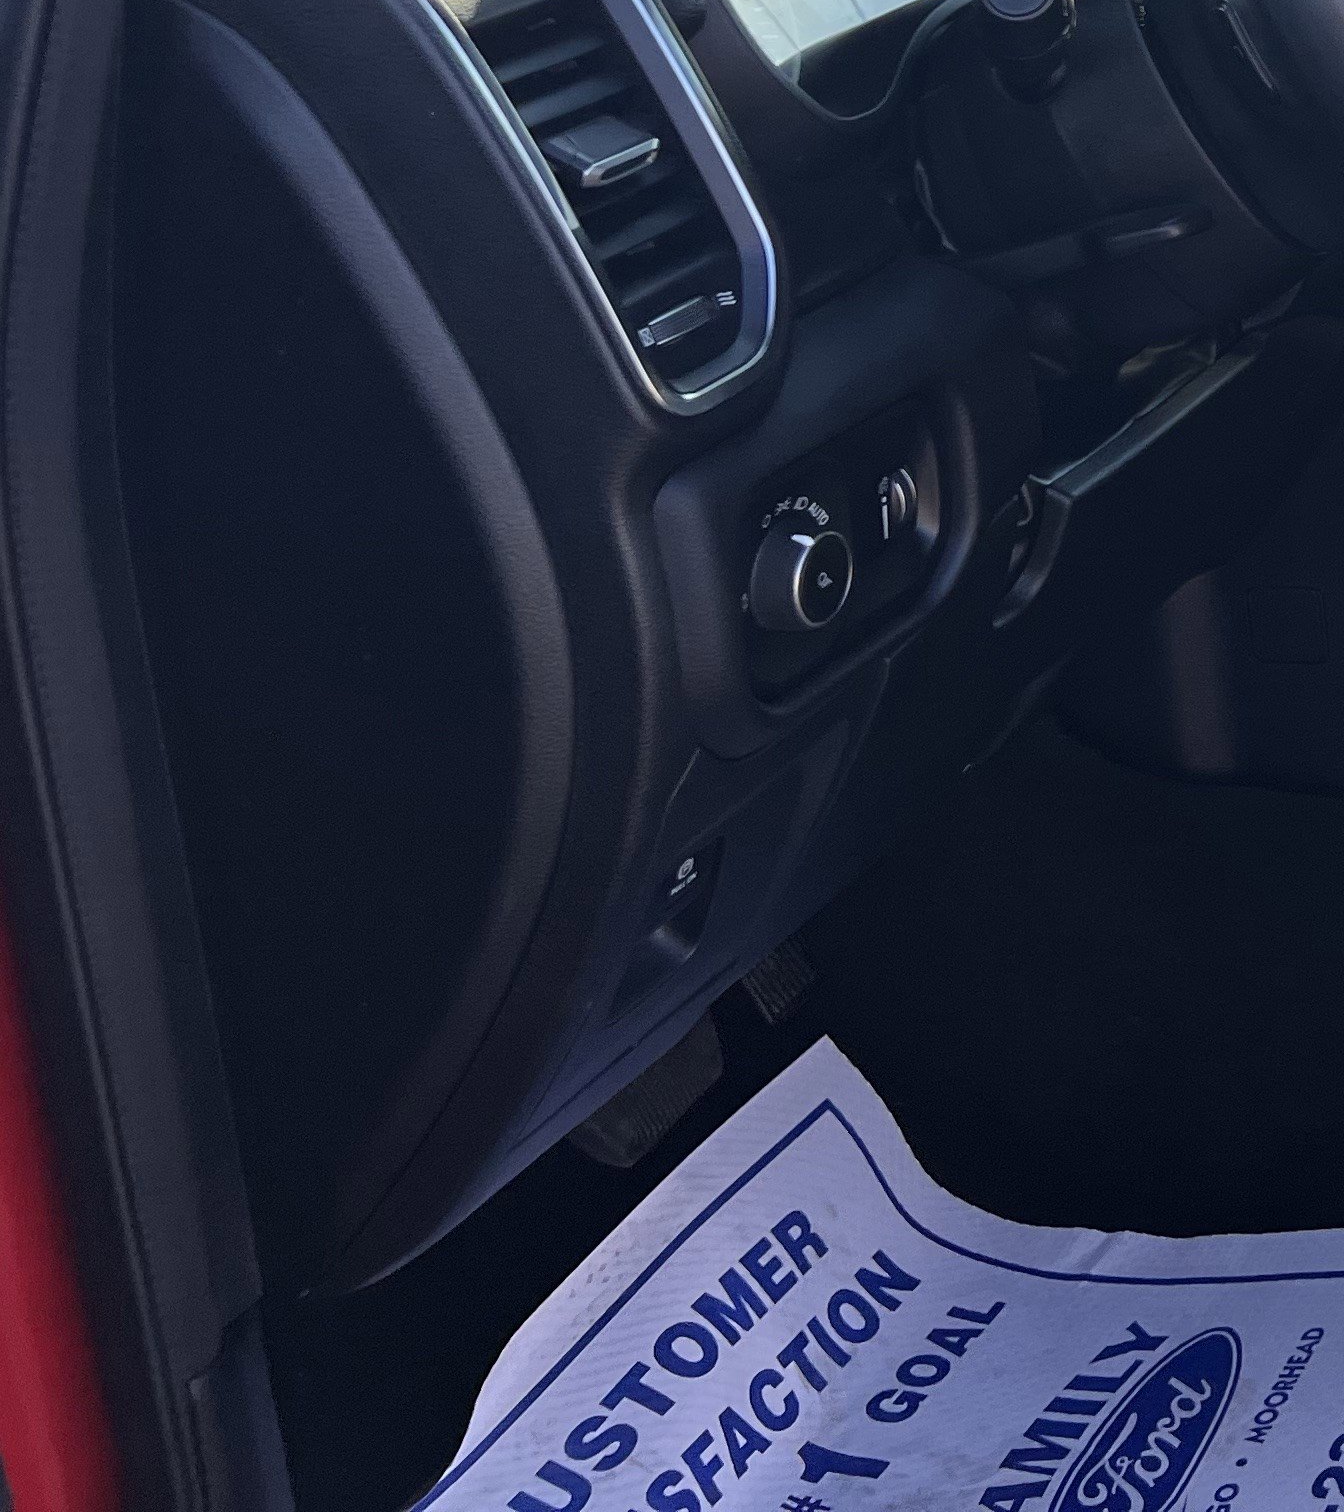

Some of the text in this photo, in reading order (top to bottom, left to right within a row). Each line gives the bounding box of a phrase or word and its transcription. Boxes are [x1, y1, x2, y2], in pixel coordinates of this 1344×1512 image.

[640, 1249, 922, 1512] SFACTION
[865, 1301, 1006, 1423] GOAL
[1244, 1326, 1325, 1444] MOORHEAD
[1076, 1376, 1212, 1512] Ford
